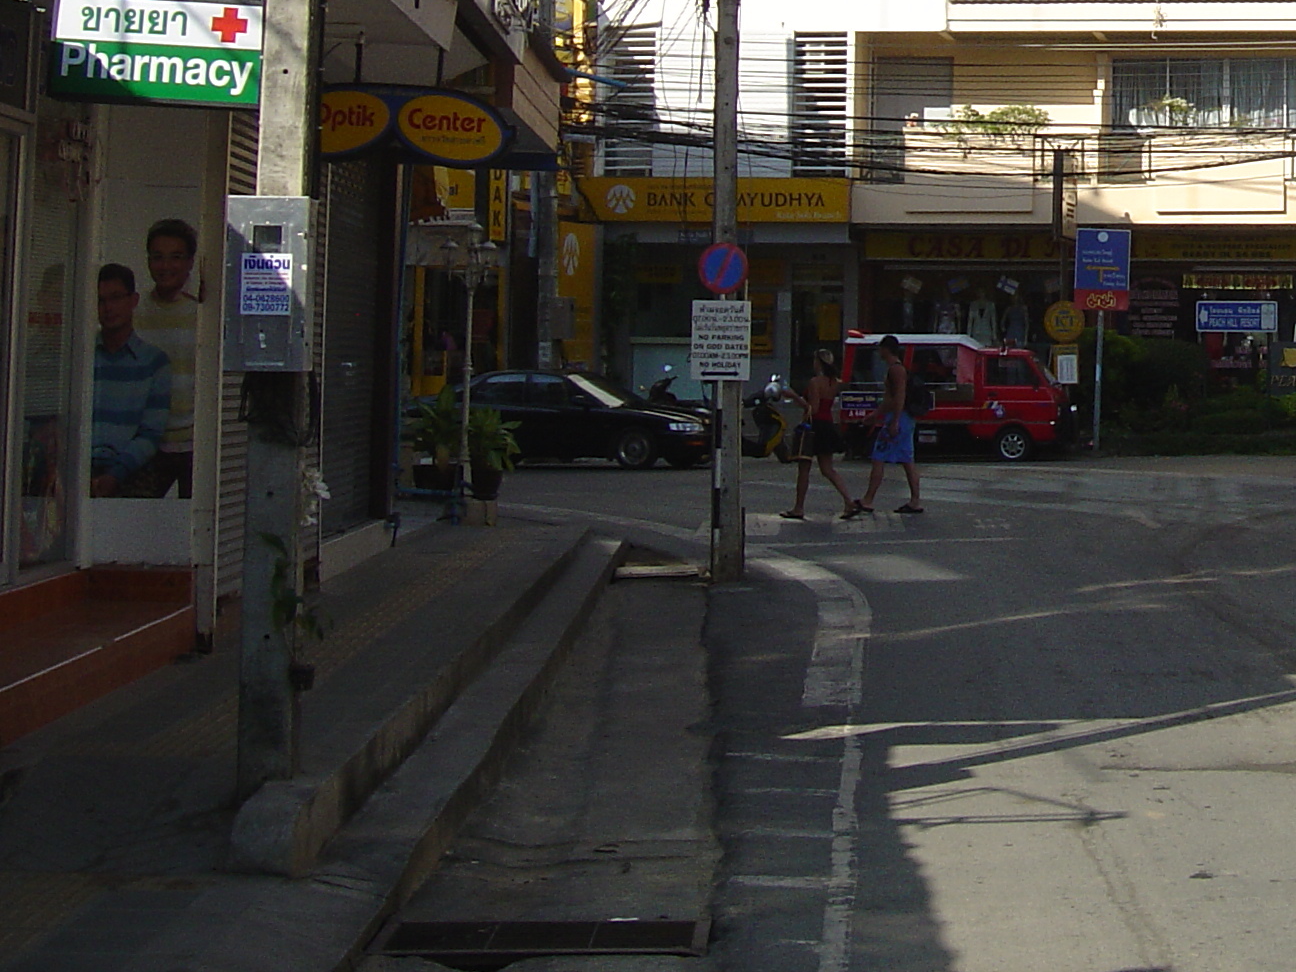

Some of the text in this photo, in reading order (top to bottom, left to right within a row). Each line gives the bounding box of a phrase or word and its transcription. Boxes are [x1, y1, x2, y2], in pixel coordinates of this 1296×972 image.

[81, 6, 188, 36] ขายยา
[61, 42, 253, 96] Pharmacy
[407, 108, 486, 133] Center
[646, 192, 695, 207] BANK
[907, 237, 984, 259] CASA
[1001, 237, 1031, 259] DI
